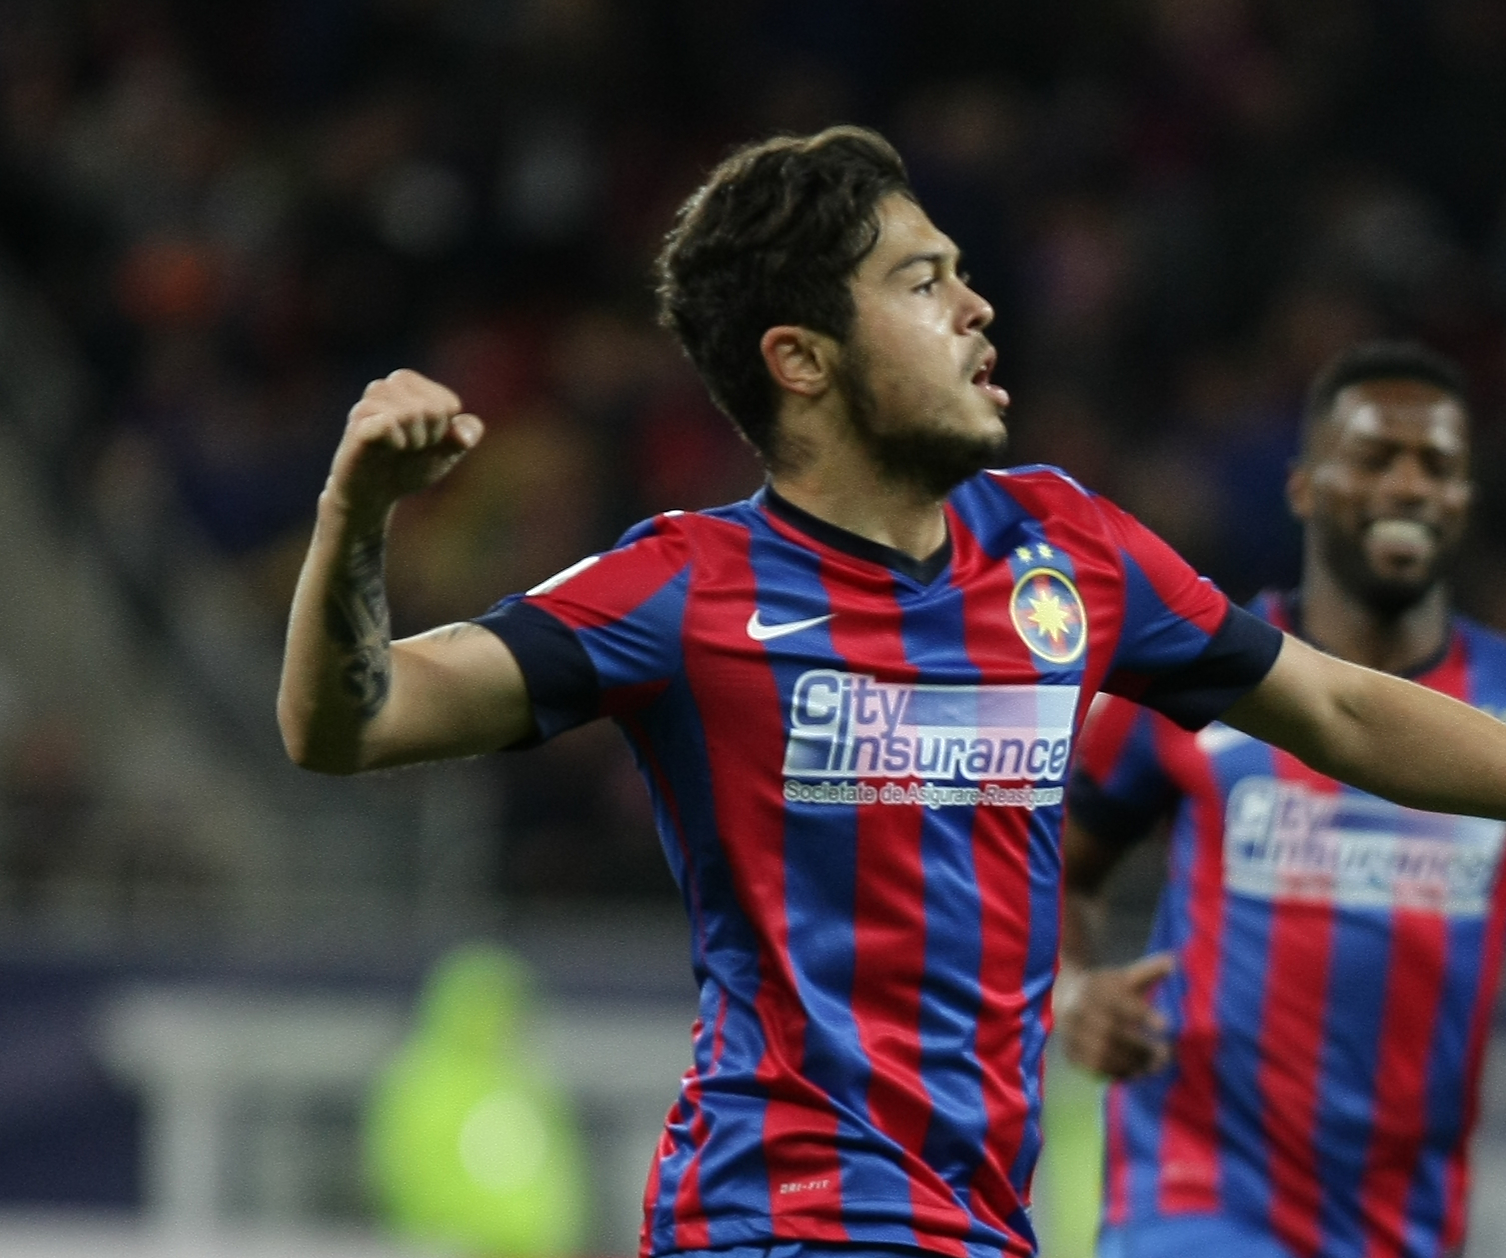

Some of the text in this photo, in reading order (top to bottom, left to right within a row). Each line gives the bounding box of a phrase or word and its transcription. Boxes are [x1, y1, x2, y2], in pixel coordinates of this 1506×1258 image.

[796, 676, 911, 738] City
[784, 780, 878, 804] Societate
[880, 782, 906, 804] de
